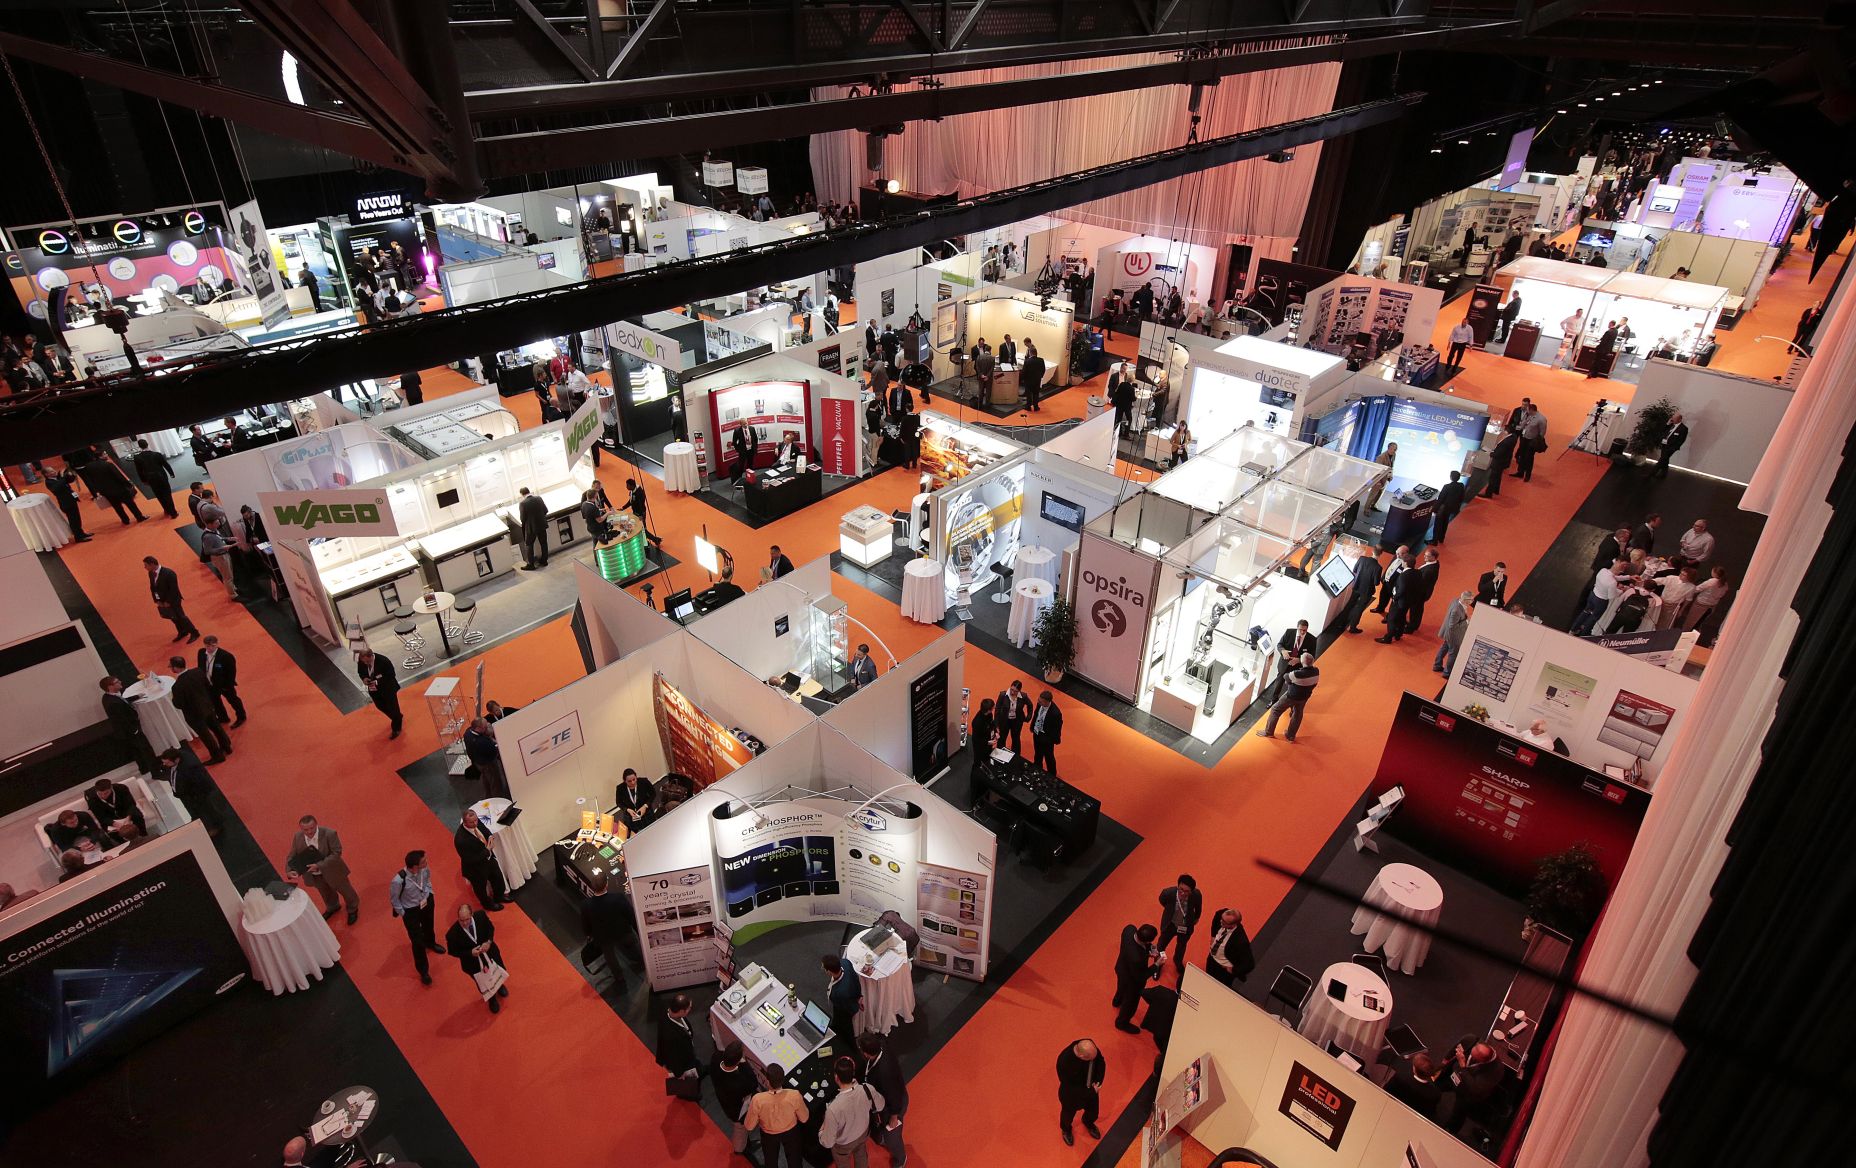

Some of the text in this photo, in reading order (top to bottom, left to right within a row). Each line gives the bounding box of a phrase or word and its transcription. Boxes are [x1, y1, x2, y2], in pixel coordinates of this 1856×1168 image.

[357, 194, 401, 211] ARROW
[374, 209, 392, 217] Years
[392, 207, 403, 215] Out
[1130, 253, 1144, 270] UL
[834, 400, 842, 431] VACUUM
[567, 408, 599, 456] WAGO
[1083, 570, 1144, 607] opsira
[1609, 637, 1650, 647] Neumüller
[669, 691, 734, 752] CONNECTED
[551, 727, 571, 745] TE
[673, 707, 723, 758] LIGHTING
[1482, 765, 1530, 788] SHARP
[859, 815, 881, 826] crytur
[724, 855, 751, 871] NEW
[769, 848, 829, 862] PHOSPHORS
[649, 880, 668, 890] 70
[643, 891, 668, 900] years
[670, 890, 696, 899] crystal
[7, 881, 167, 962] Connected Illumination
[26, 945, 57, 965] platform
[56, 929, 87, 949] solutions
[1297, 1086, 1337, 1116] professional
[1300, 1074, 1342, 1111] LED
